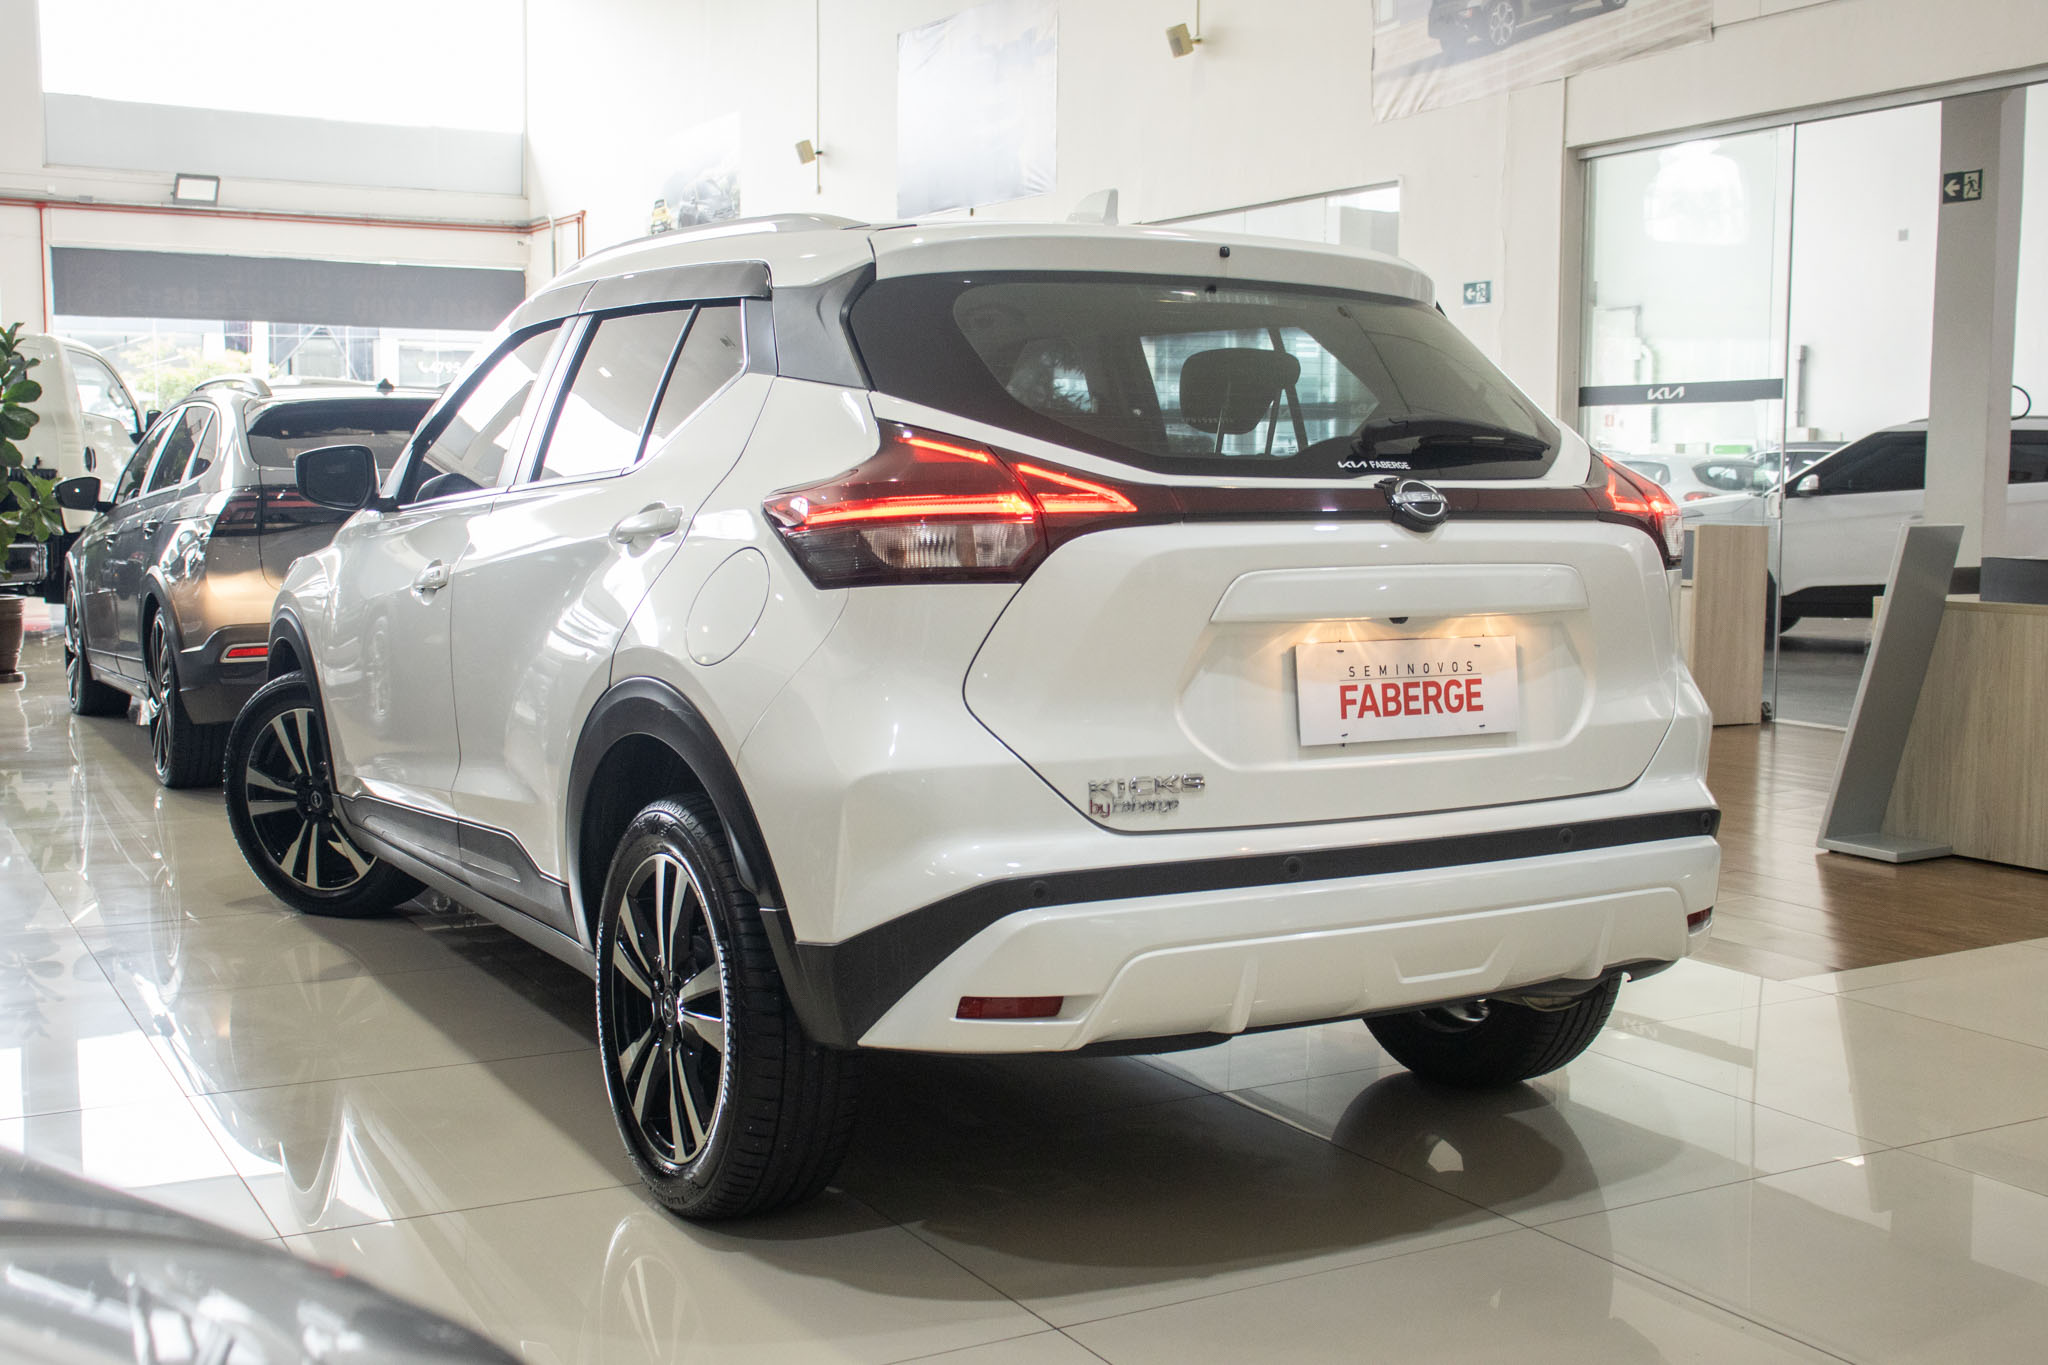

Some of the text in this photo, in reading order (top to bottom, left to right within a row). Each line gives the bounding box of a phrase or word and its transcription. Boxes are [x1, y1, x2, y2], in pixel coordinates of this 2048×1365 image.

[1647, 386, 1685, 400] KIA
[1337, 460, 1411, 470] KIA FABERGE
[1394, 492, 1447, 503] NISSAN
[1348, 661, 1473, 677] SEMINOVOS
[1340, 678, 1484, 720] FABERGE
[1088, 774, 1205, 799] KICKS
[1089, 799, 1111, 818] by
